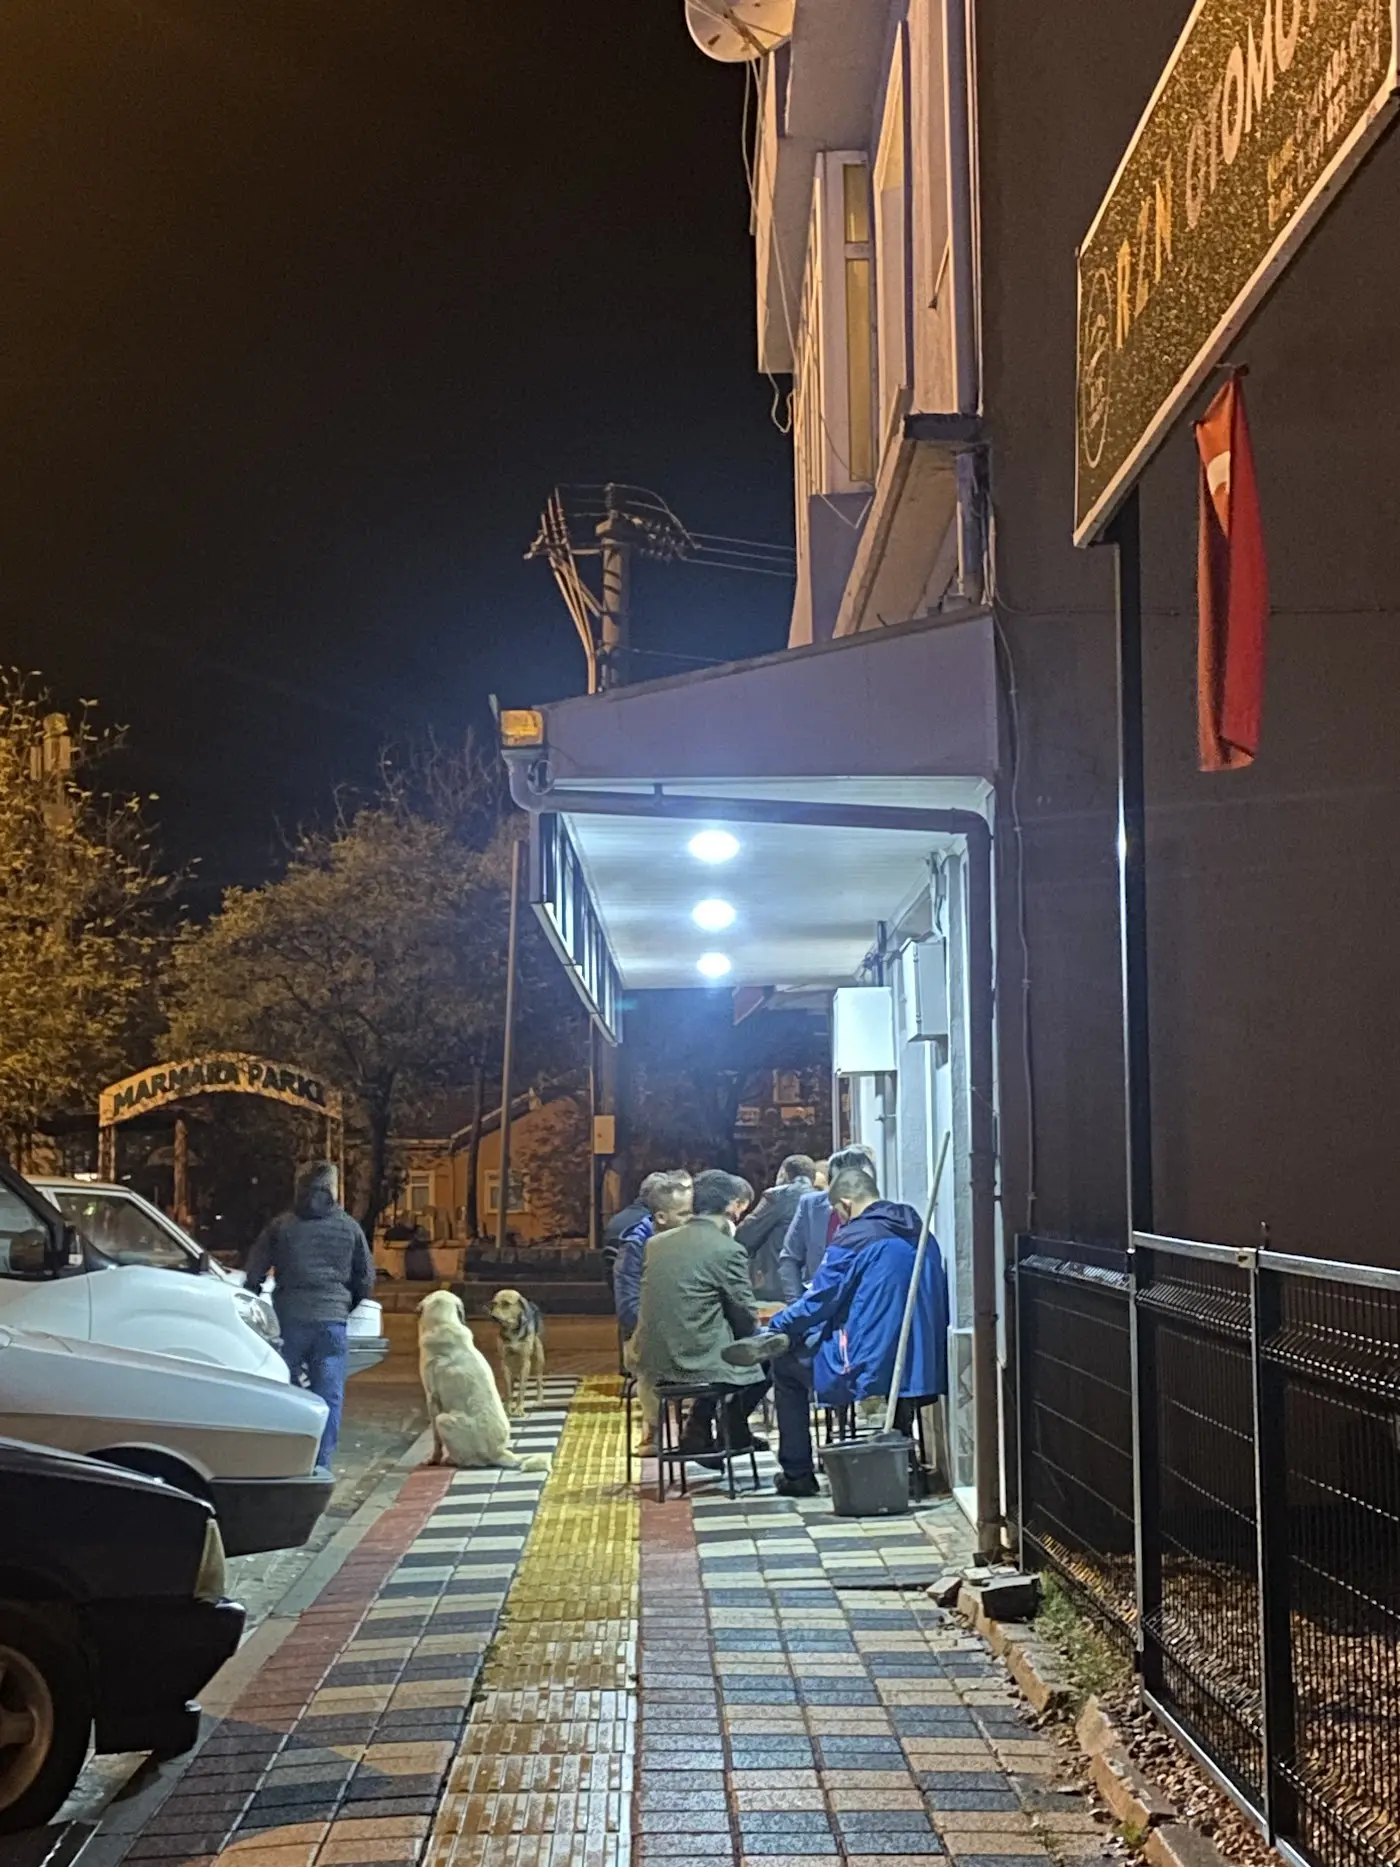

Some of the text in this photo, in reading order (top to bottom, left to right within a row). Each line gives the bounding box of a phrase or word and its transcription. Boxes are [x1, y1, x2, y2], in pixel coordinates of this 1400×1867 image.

[1185, 0, 1318, 231] OTOMO
[113, 1062, 327, 1117] MARMARA PARKI
